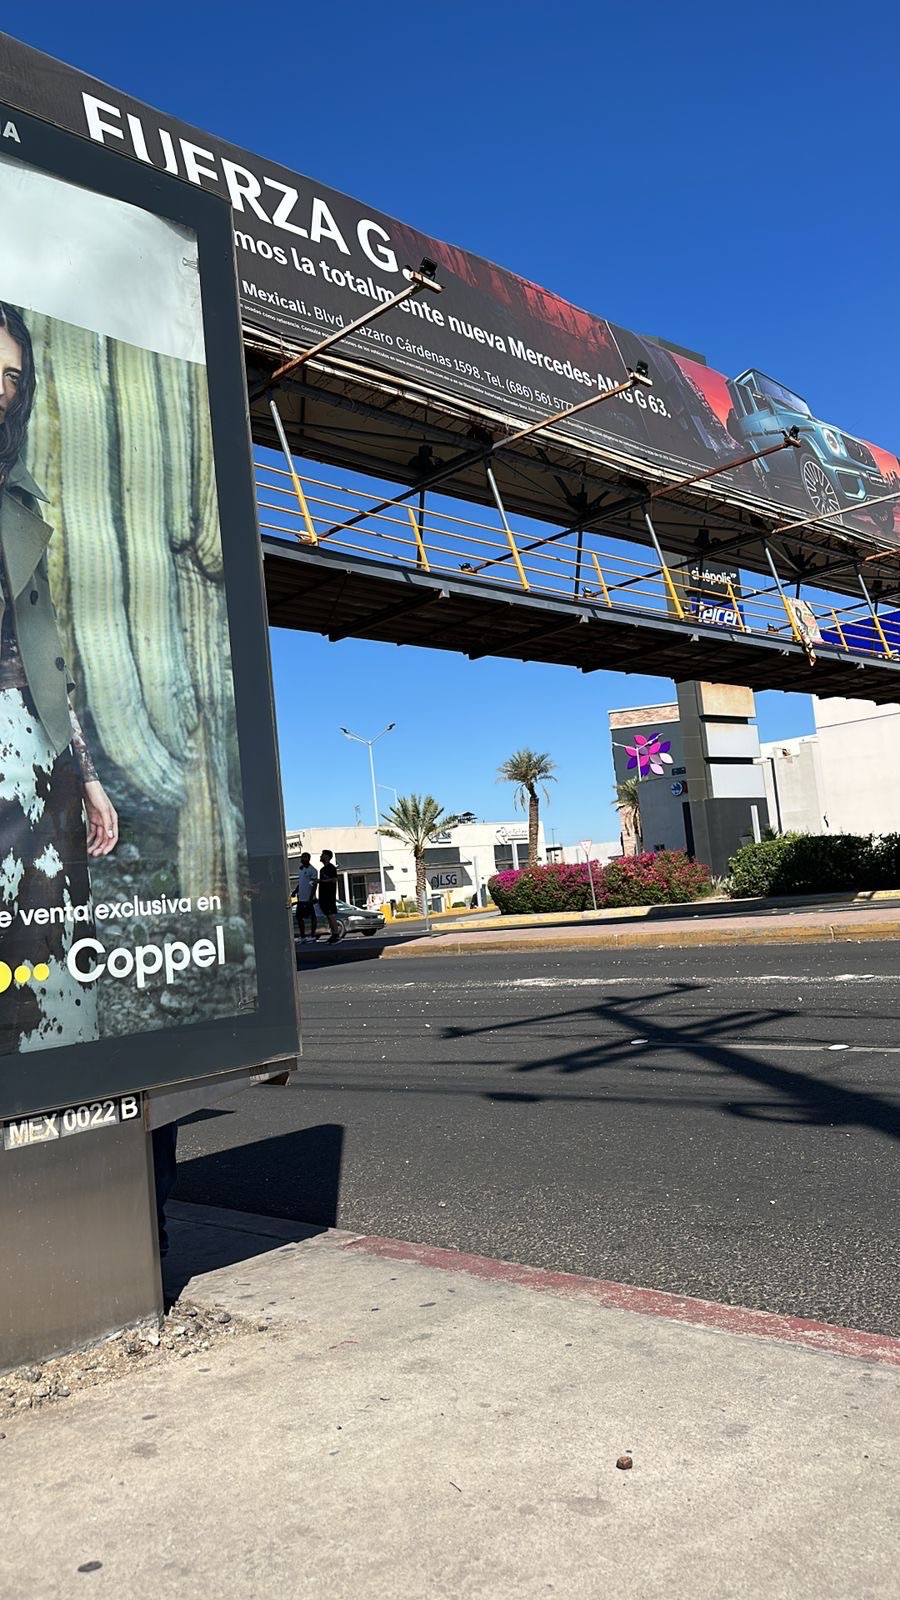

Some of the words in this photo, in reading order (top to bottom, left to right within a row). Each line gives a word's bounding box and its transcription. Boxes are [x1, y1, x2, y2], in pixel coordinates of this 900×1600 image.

[241, 279, 312, 318] Mexicali.
[396, 336, 452, 368] Cárdenas
[452, 358, 485, 380] 1598.
[483, 370, 505, 389] Tel.
[505, 378, 534, 402] (686)
[534, 389, 553, 407] 561
[290, 246, 317, 277] la
[447, 315, 507, 353] nueva
[634, 388, 648, 410] G
[647, 394, 672, 419] 63.
[440, 873, 457, 886] LSG
[20, 904, 90, 926] venta
[95, 894, 191, 921] exclusiva
[196, 895, 221, 912] en
[67, 925, 225, 988] Coppel
[8, 1112, 60, 1147] MEX
[62, 1100, 117, 1132] 0022
[121, 1096, 139, 1120] B
